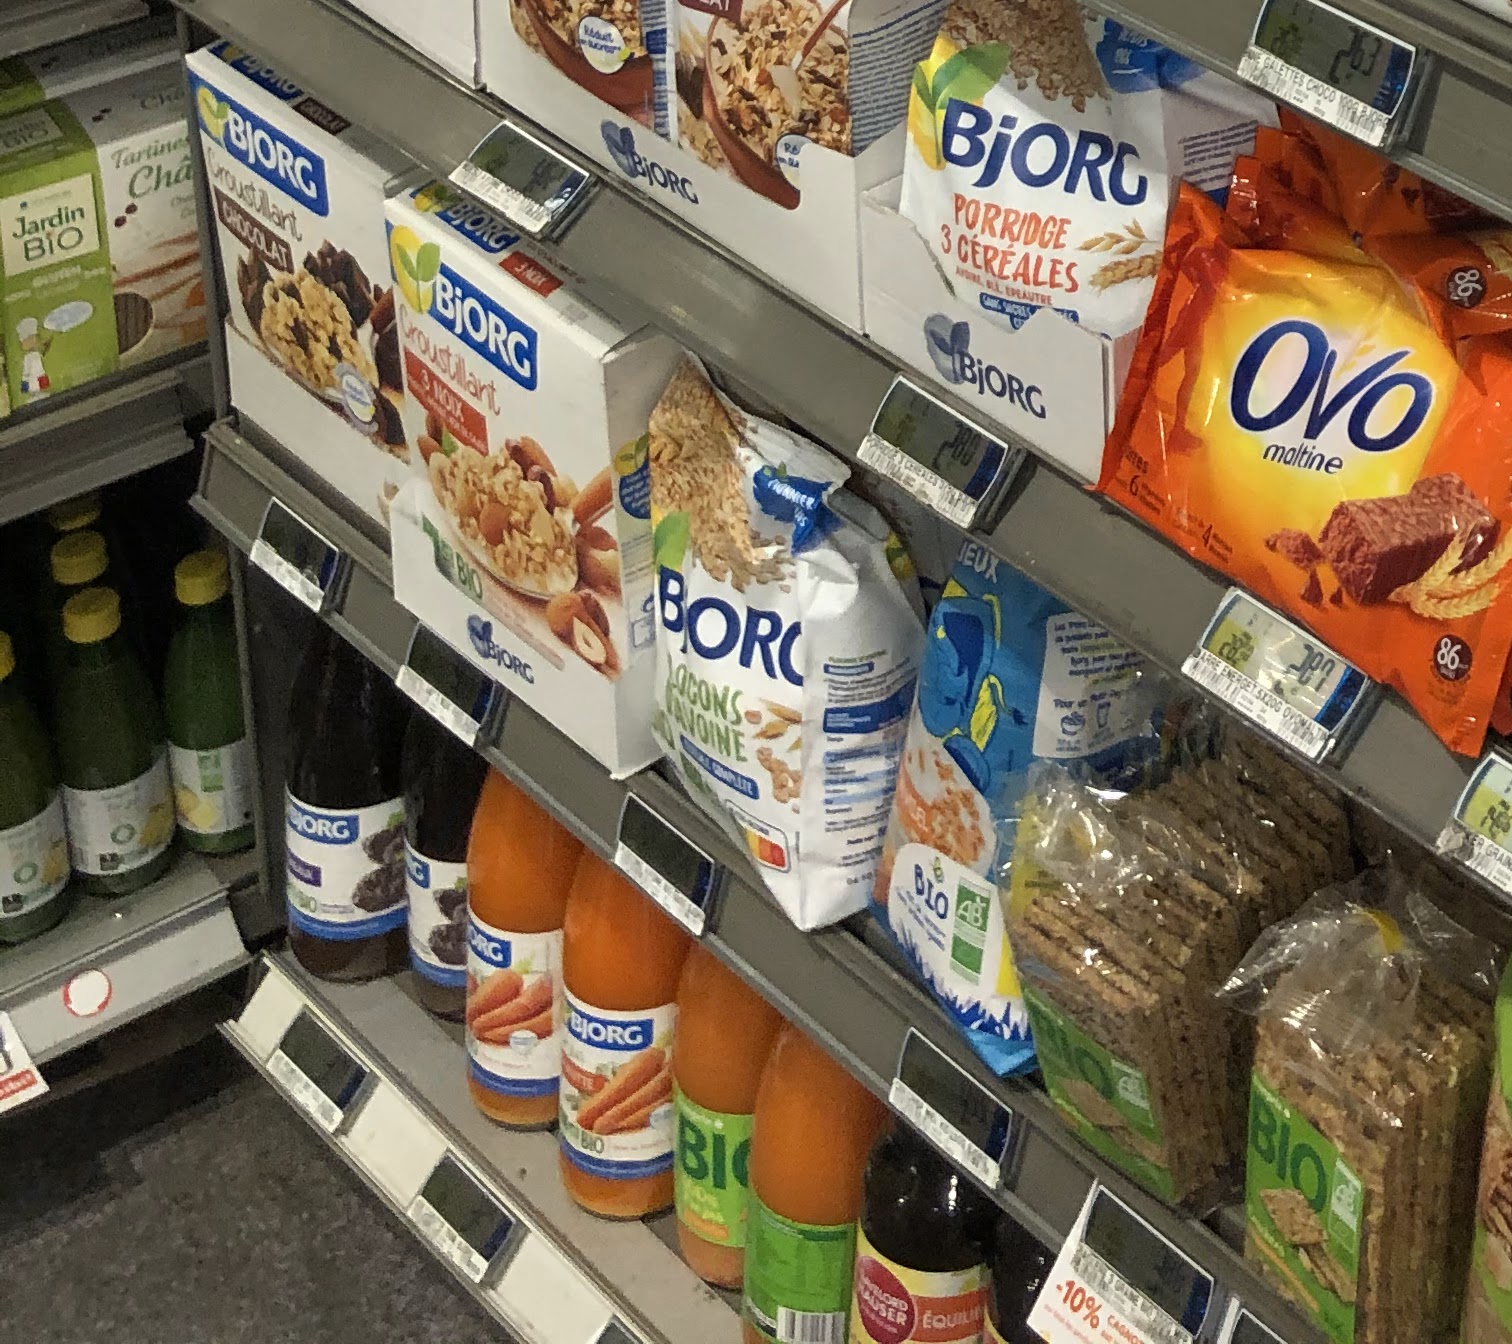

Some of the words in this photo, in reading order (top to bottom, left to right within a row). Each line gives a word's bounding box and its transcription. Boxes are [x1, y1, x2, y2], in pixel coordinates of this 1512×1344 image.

[229, 113, 319, 196] BJORG
[12, 204, 84, 240] Jardin
[223, 203, 290, 267] CHOCOLAT
[952, 192, 1073, 252] PORRIDGE
[940, 222, 953, 255] 3
[957, 238, 1080, 295] CÉRÉALES
[1262, 441, 1345, 475] maltine
[571, 1010, 644, 1046] BJORG
[1252, 1104, 1328, 1214] BIO
